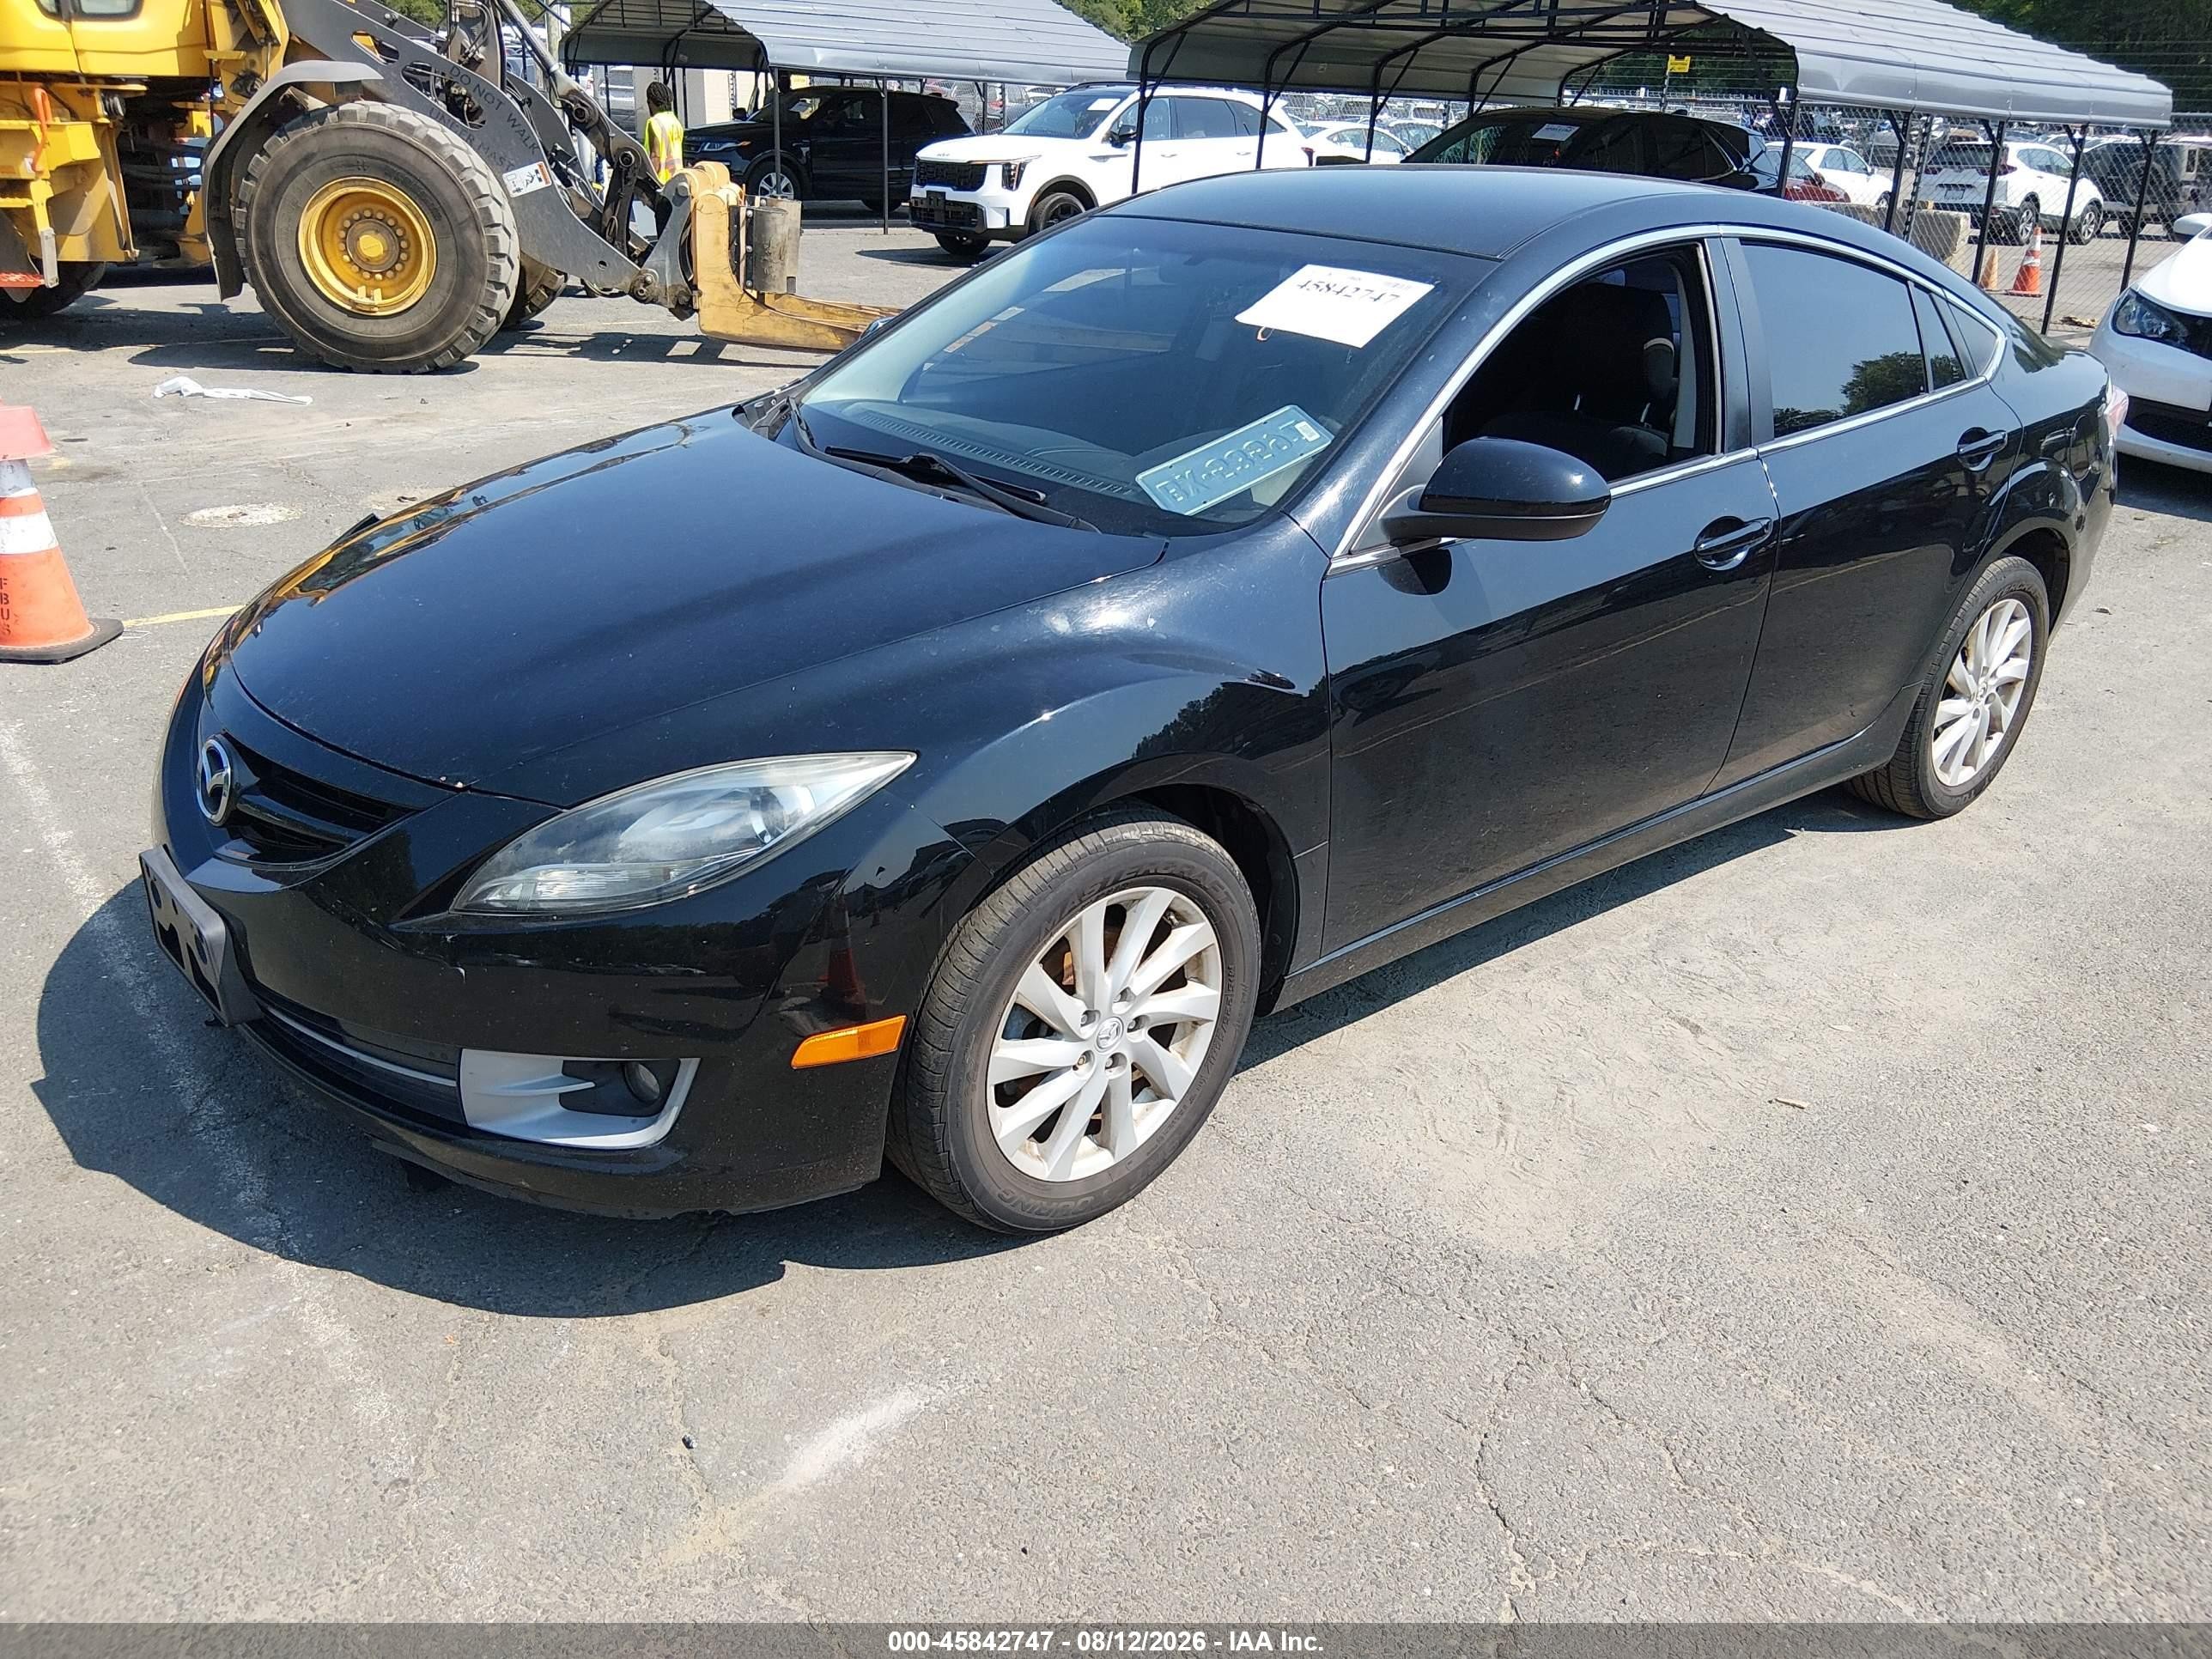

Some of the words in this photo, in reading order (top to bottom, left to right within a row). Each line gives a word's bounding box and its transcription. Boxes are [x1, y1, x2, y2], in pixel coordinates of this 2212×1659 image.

[428, 106, 475, 146] UNDER
[477, 142, 516, 173] MAST
[450, 65, 471, 86] DO
[473, 83, 504, 112] NOT
[506, 112, 541, 155] WALK
[1297, 280, 1401, 303] 45842747
